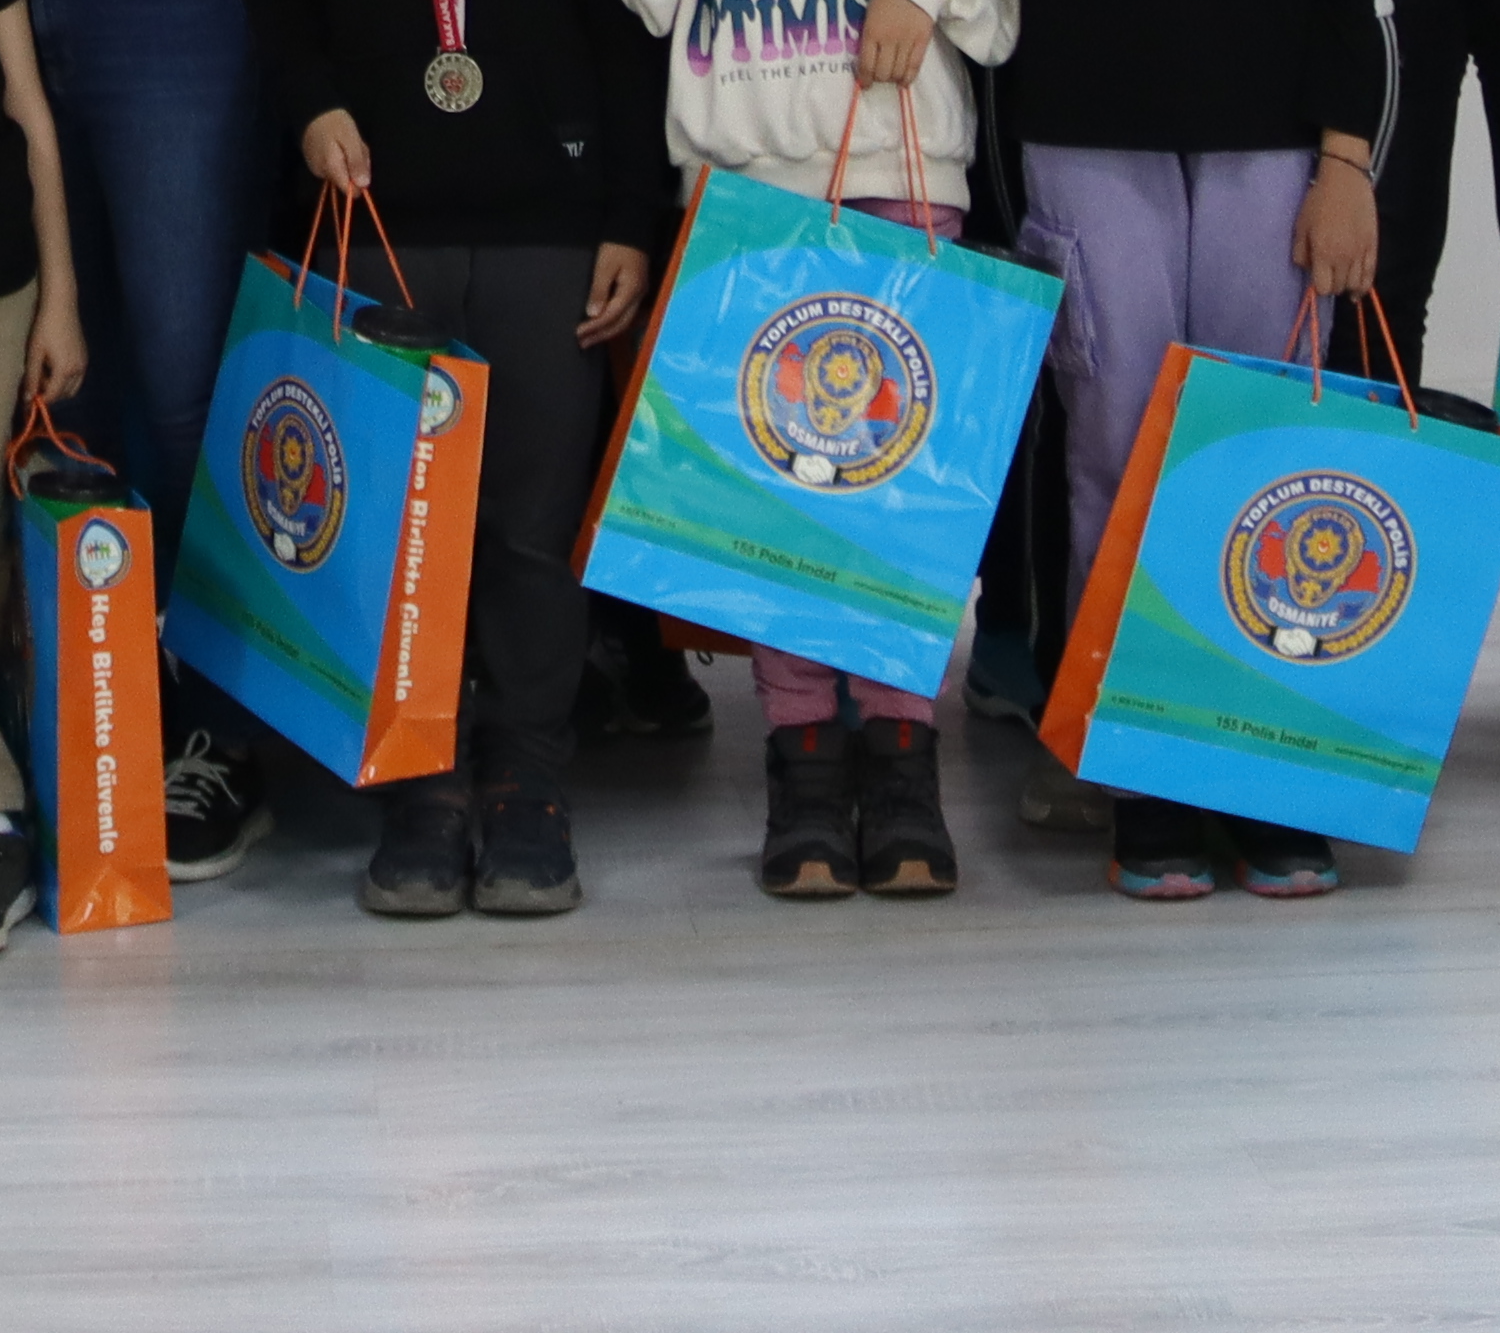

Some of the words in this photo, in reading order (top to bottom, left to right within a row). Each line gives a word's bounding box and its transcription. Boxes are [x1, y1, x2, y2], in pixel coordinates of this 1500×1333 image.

[720, 70, 753, 86] FEEL
[761, 67, 794, 80] THE
[759, 301, 824, 350] TOPLUM
[827, 300, 909, 347] DESTEKLİ
[902, 345, 930, 399] POLİS
[1241, 481, 1306, 530] TOPLUM
[1308, 477, 1392, 520] DESTEKLİ
[1383, 518, 1410, 569] POLİS
[88, 594, 111, 643] Hep
[1267, 596, 1340, 628] OSMANİYE
[92, 651, 115, 749] Birlikte
[96, 754, 119, 855] Güvenle
